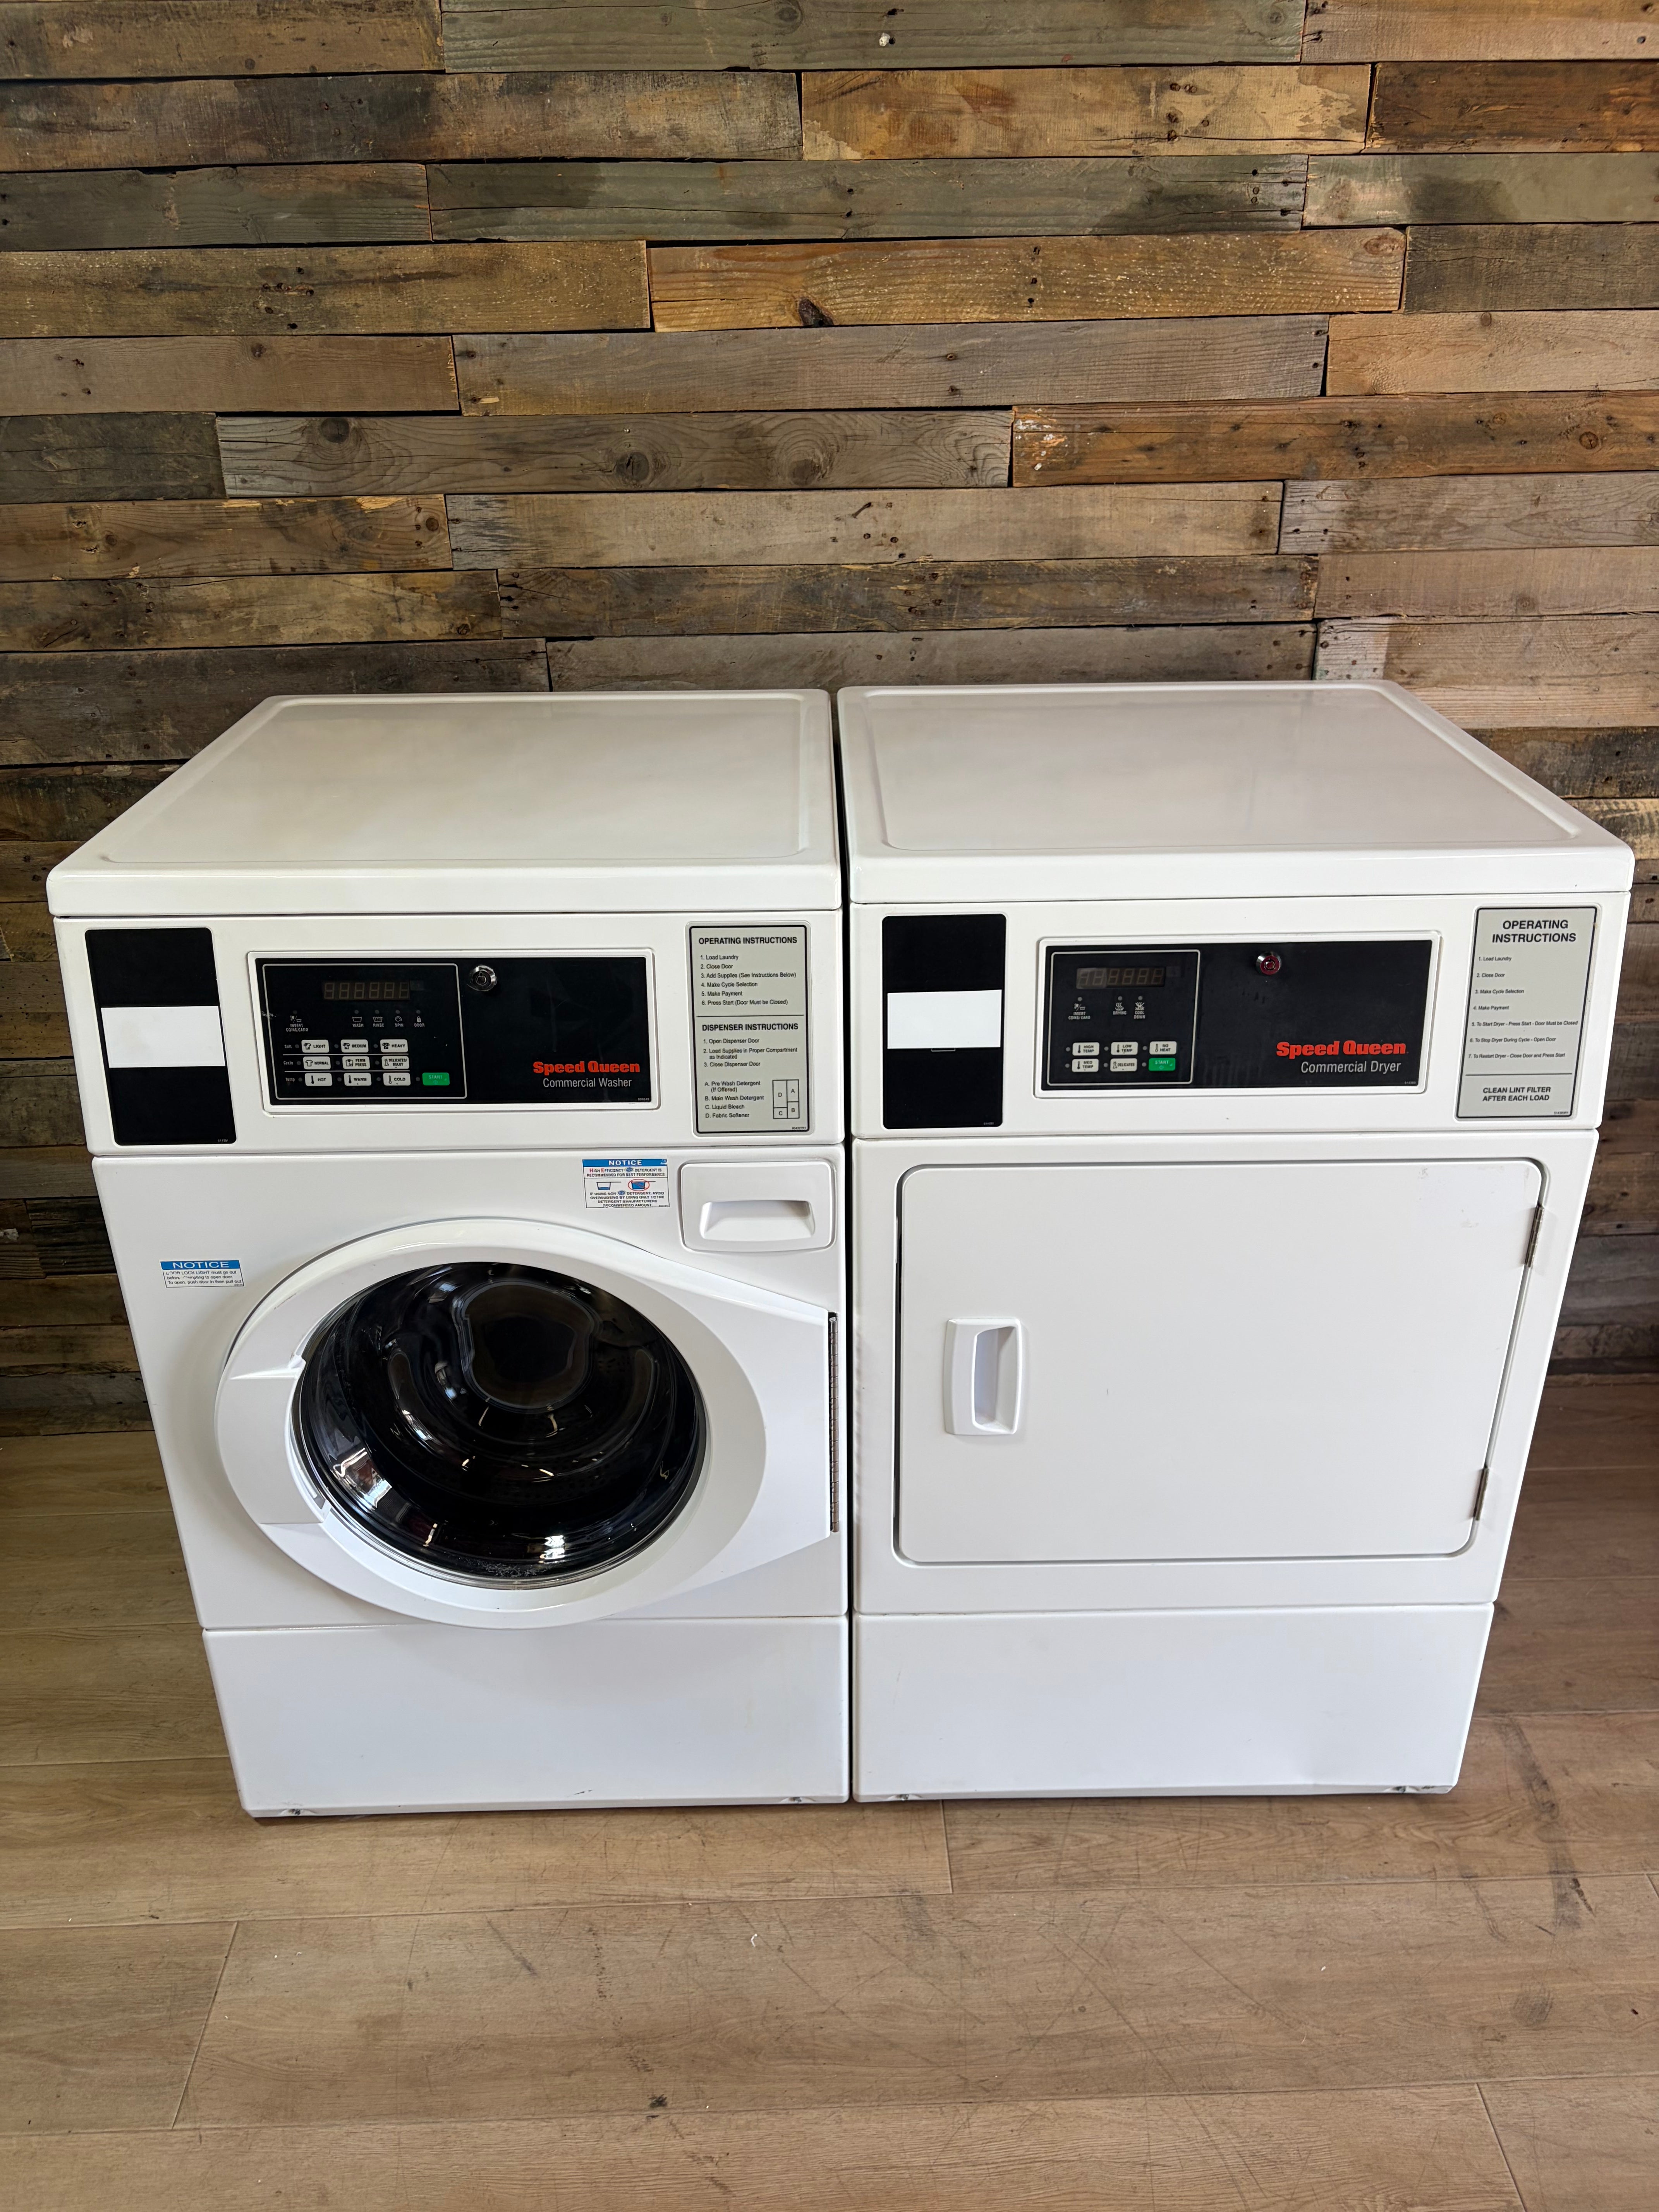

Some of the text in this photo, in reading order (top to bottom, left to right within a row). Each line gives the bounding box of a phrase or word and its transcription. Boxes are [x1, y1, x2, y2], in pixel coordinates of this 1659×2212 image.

[1503, 920, 1568, 929] OPERATING
[1492, 933, 1577, 943] INSTRUCTIONS
[1276, 1040, 1406, 1059] Speed Queen
[533, 1060, 640, 1075] Speed Queen
[1301, 1060, 1401, 1074] Commercial Dryer
[543, 1077, 632, 1087] Commercial Washer
